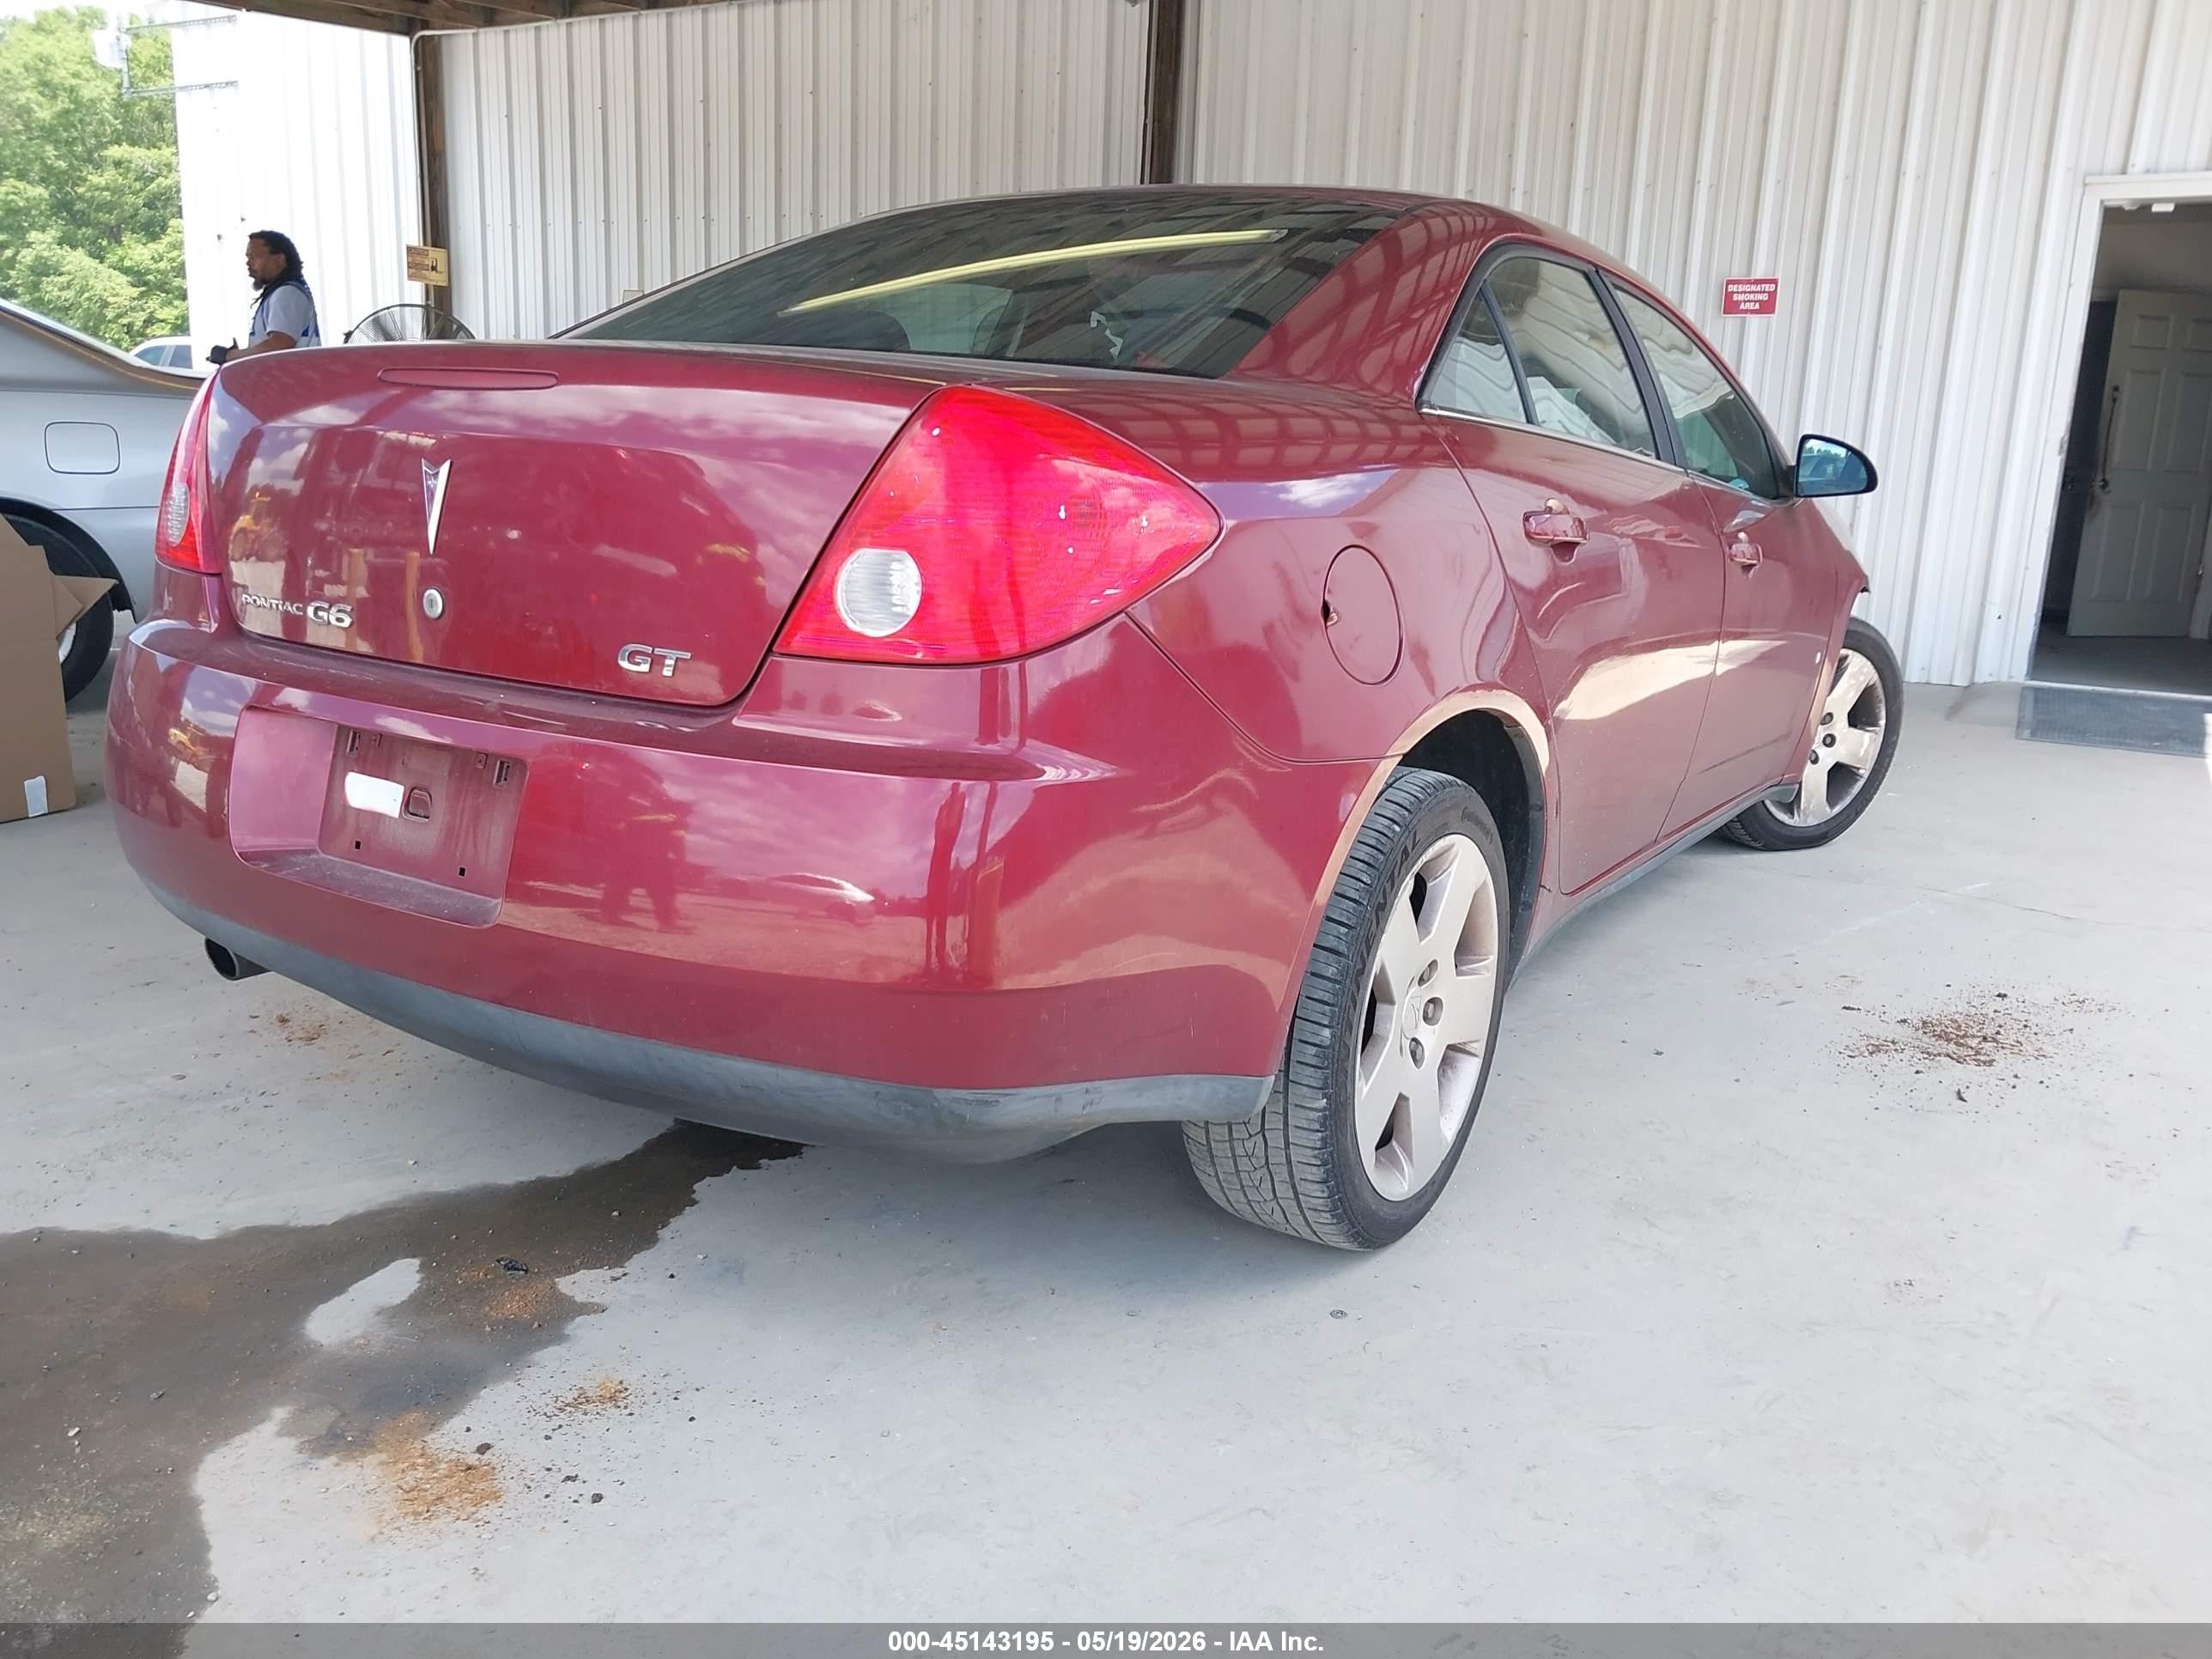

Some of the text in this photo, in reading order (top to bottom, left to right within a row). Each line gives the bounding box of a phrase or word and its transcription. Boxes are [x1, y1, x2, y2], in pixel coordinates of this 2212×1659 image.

[241, 593, 353, 628] PONTIAC G6
[617, 643, 692, 677] GT
